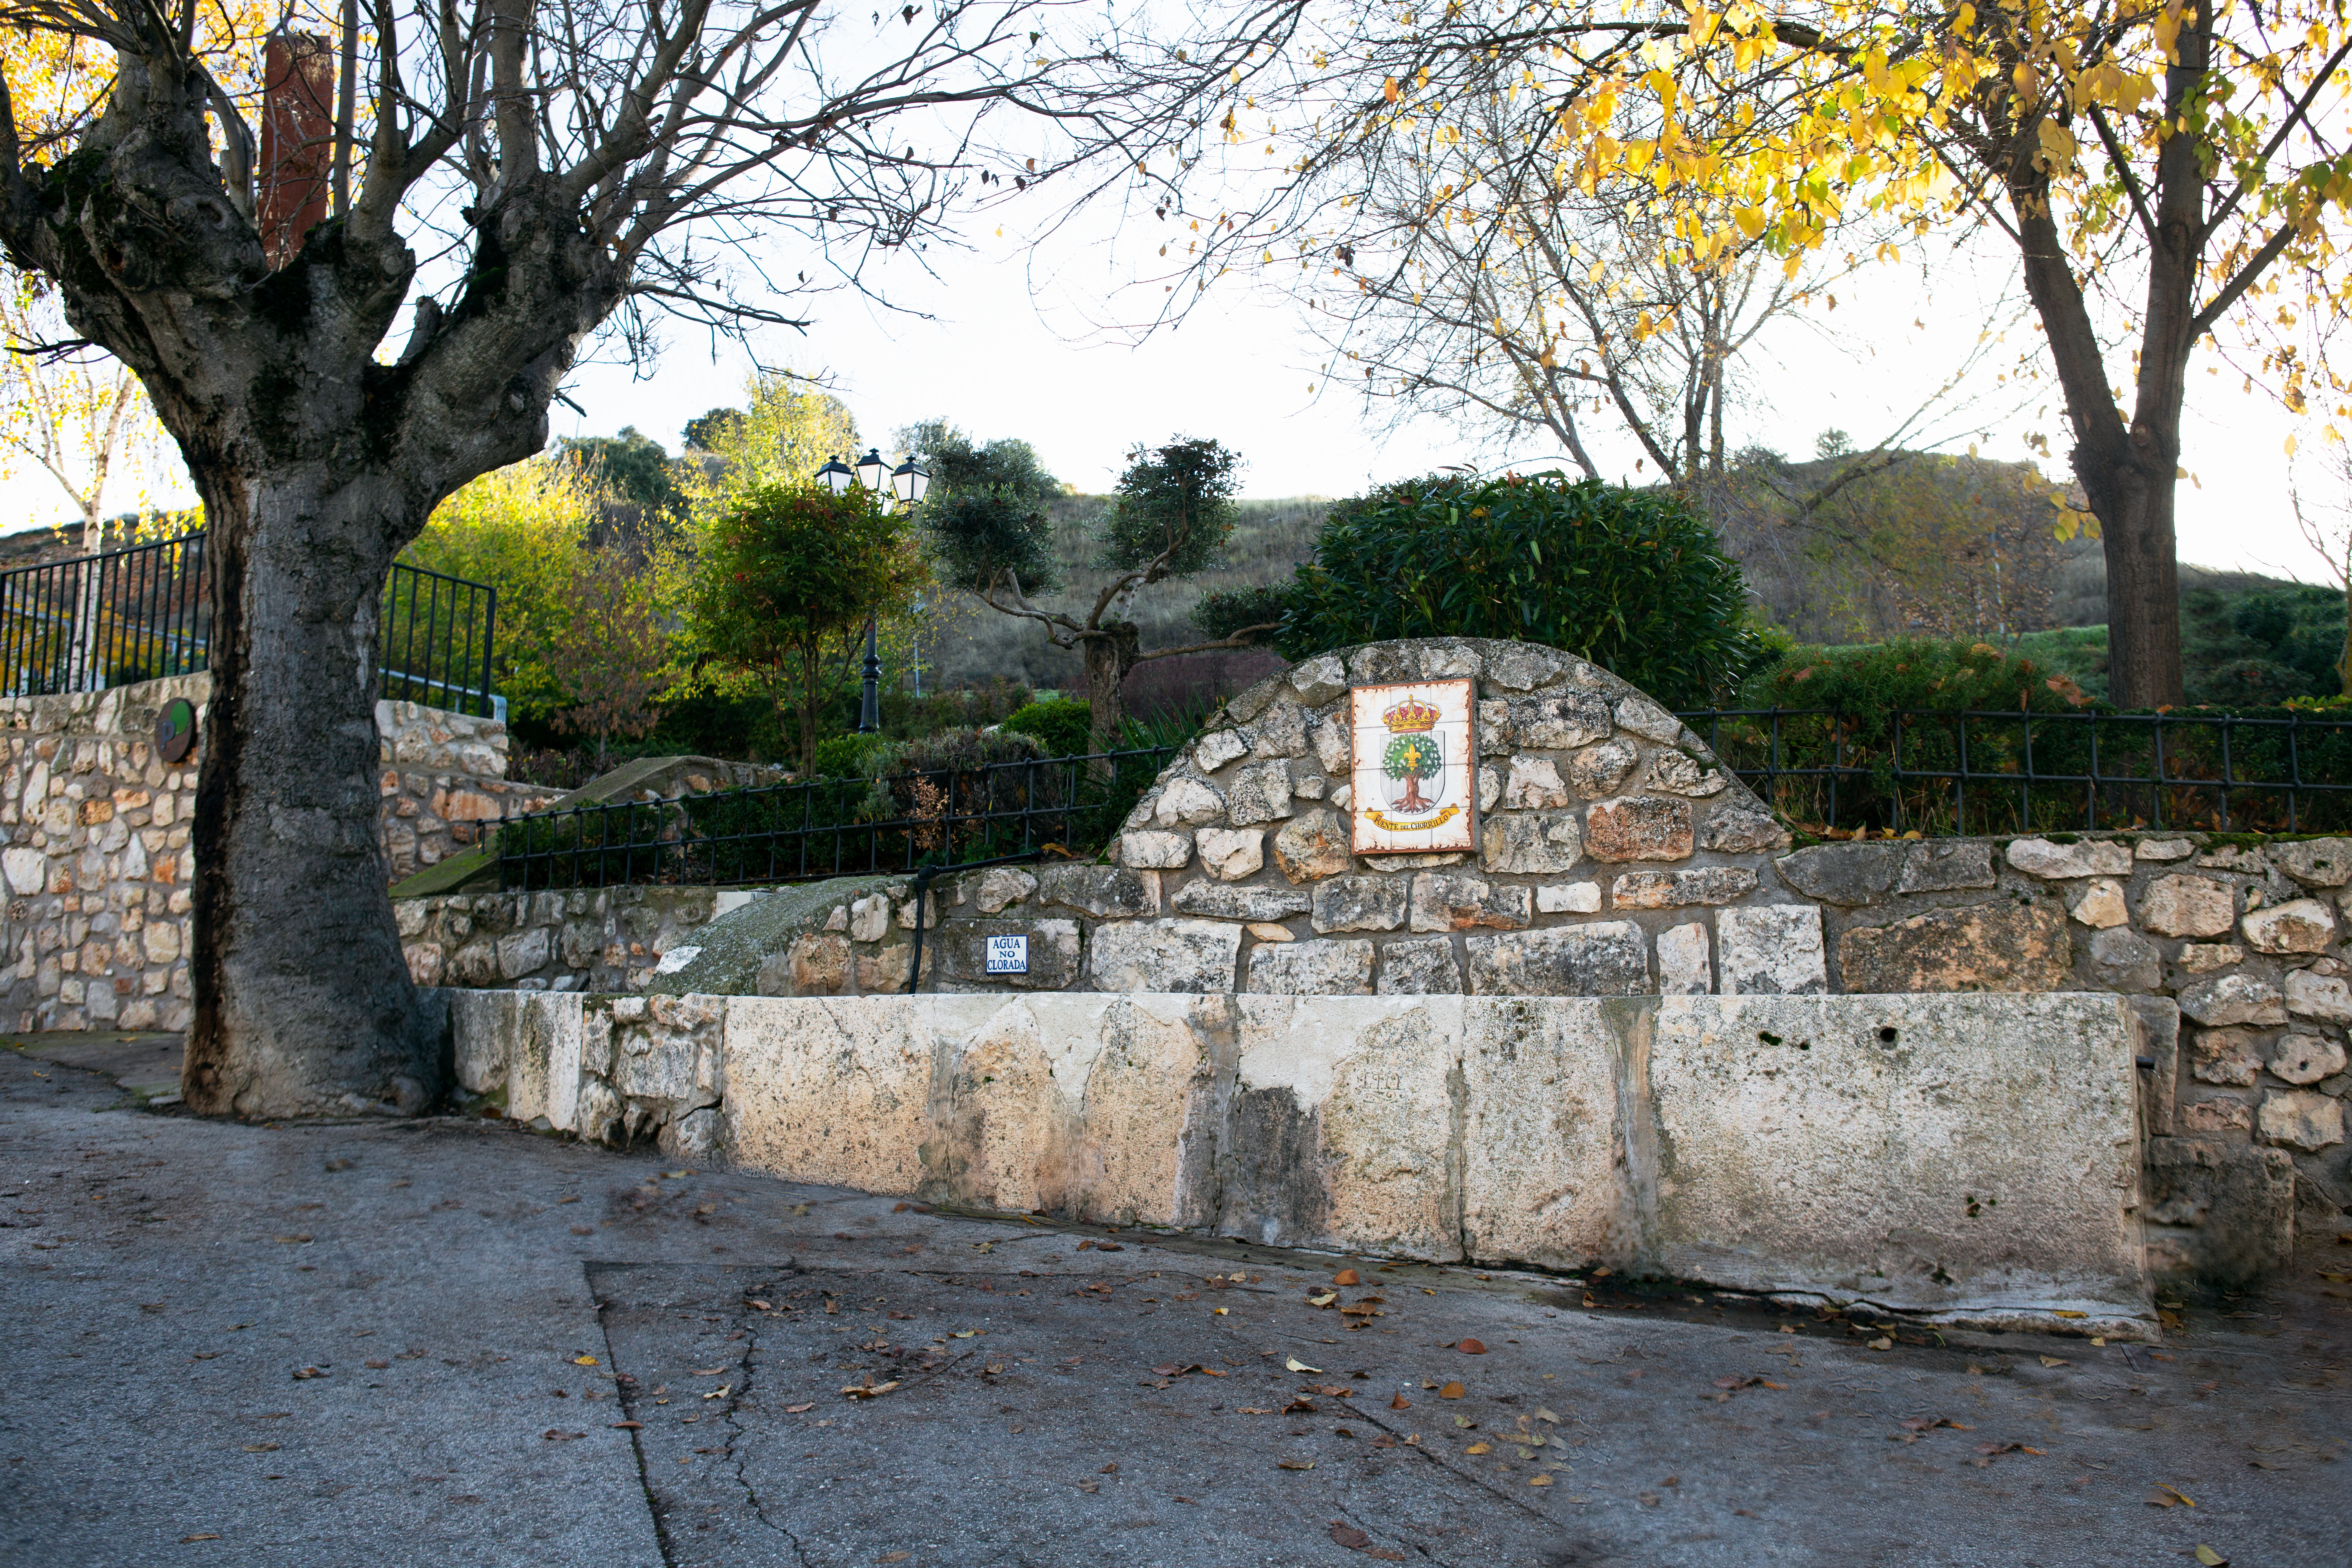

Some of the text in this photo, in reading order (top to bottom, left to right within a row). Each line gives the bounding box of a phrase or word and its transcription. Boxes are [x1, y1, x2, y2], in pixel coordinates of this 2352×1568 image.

[160, 720, 176, 752] P
[1374, 816, 1399, 830] FUENTE
[1411, 815, 1448, 830] CHORRILLO
[993, 938, 1020, 949] AGUA
[987, 960, 1026, 970] CLORADA
